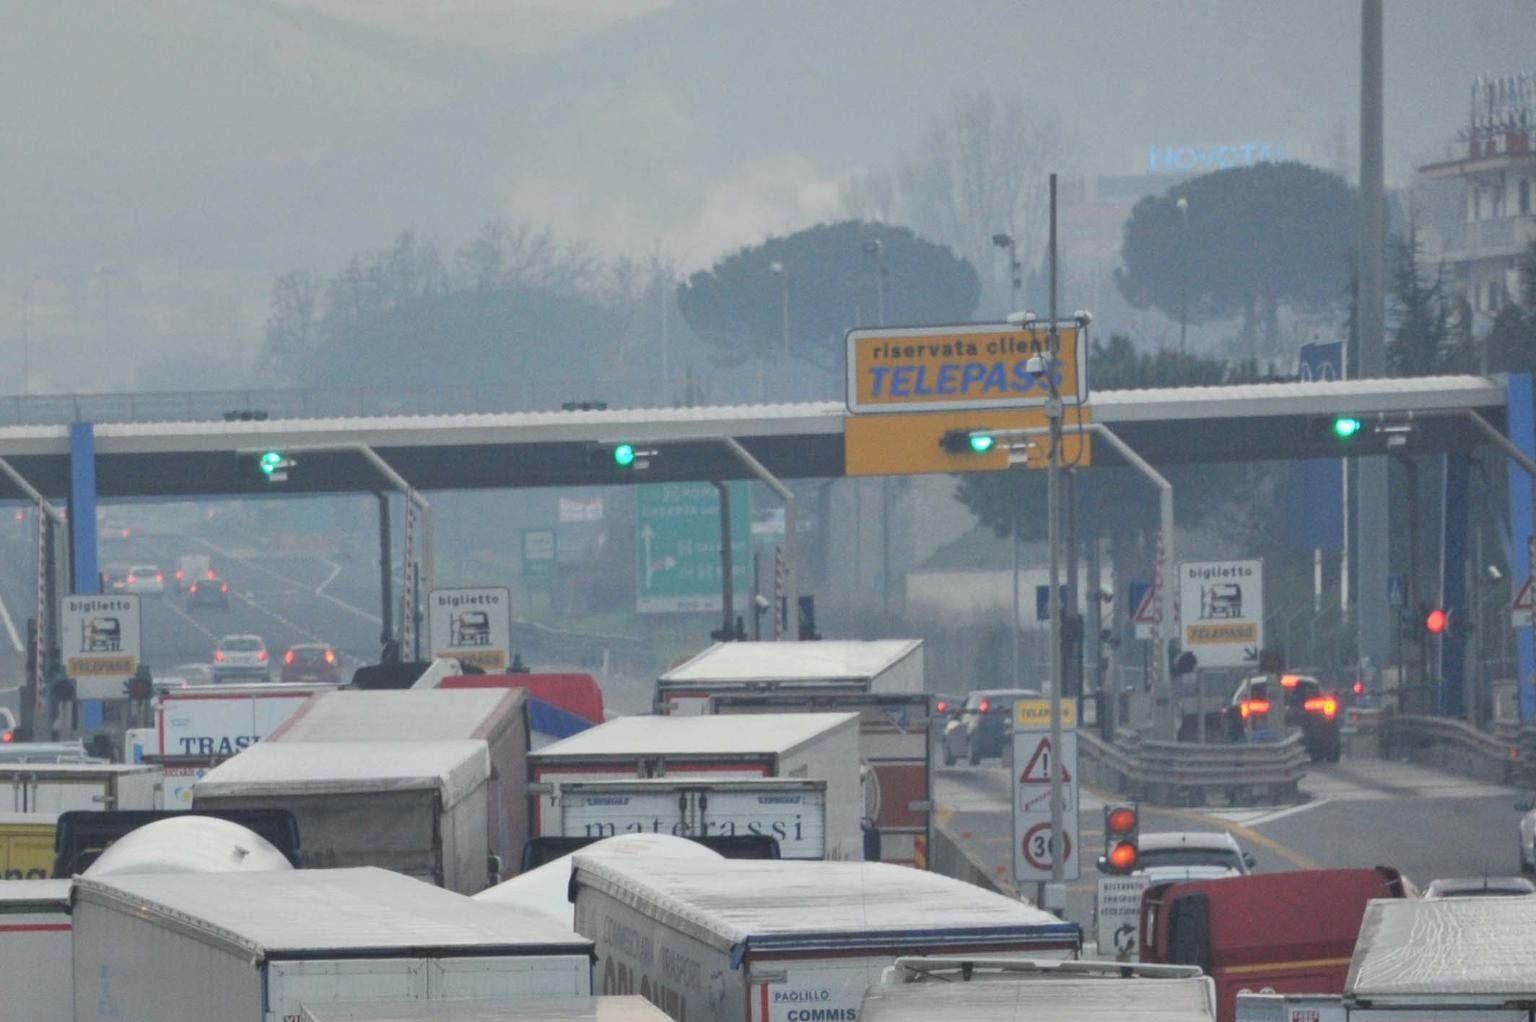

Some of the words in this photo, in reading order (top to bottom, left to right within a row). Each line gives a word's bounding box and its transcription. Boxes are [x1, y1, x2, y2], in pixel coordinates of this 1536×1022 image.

[873, 342, 978, 359] riservata
[1189, 565, 1253, 579] biglietto
[70, 600, 131, 613] biglietto
[438, 594, 500, 606] biglietto
[180, 736, 262, 755] TRAS
[584, 813, 804, 841] materassi
[787, 1008, 856, 1022] COMMIS
